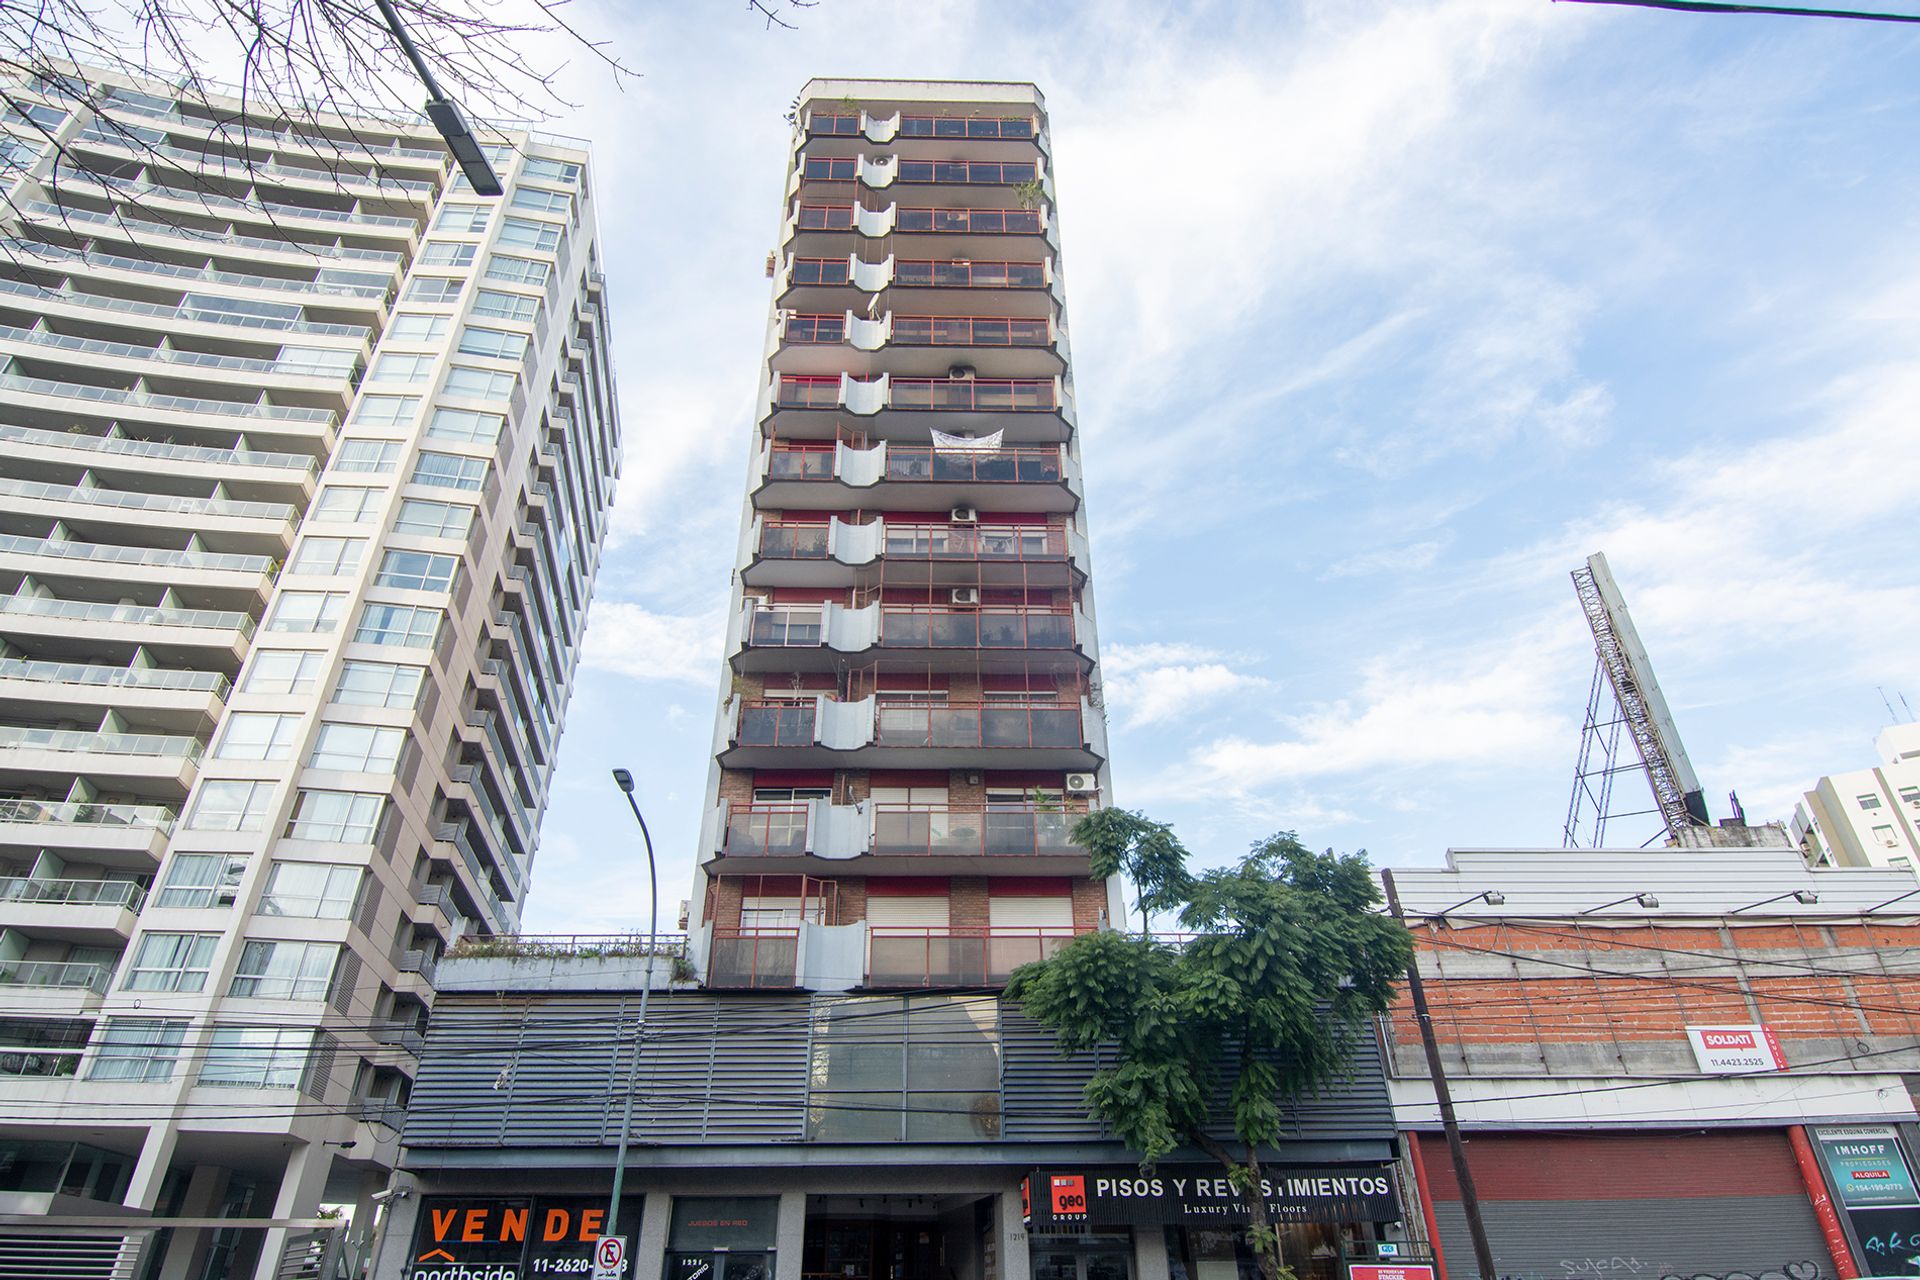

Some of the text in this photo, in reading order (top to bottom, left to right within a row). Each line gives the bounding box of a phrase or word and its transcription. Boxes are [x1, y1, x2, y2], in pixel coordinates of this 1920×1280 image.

[1706, 1034, 1752, 1046] SOLDATI
[1765, 1026, 1785, 1069] ALQUILA
[1710, 1058, 1764, 1067] 11.4423.2525
[1834, 1144, 1885, 1156] IMHOFF
[1840, 1160, 1891, 1168] PROPIEDADES
[1096, 1177, 1389, 1197] PISOS Y REVSIMIENTOS
[1058, 1194, 1084, 1210] gea
[1184, 1204, 1228, 1215] Luxury
[1269, 1203, 1307, 1213] Floors
[431, 1208, 606, 1242] VENDE
[1010, 1233, 1025, 1241] 1219
[682, 1258, 703, 1266] 1221
